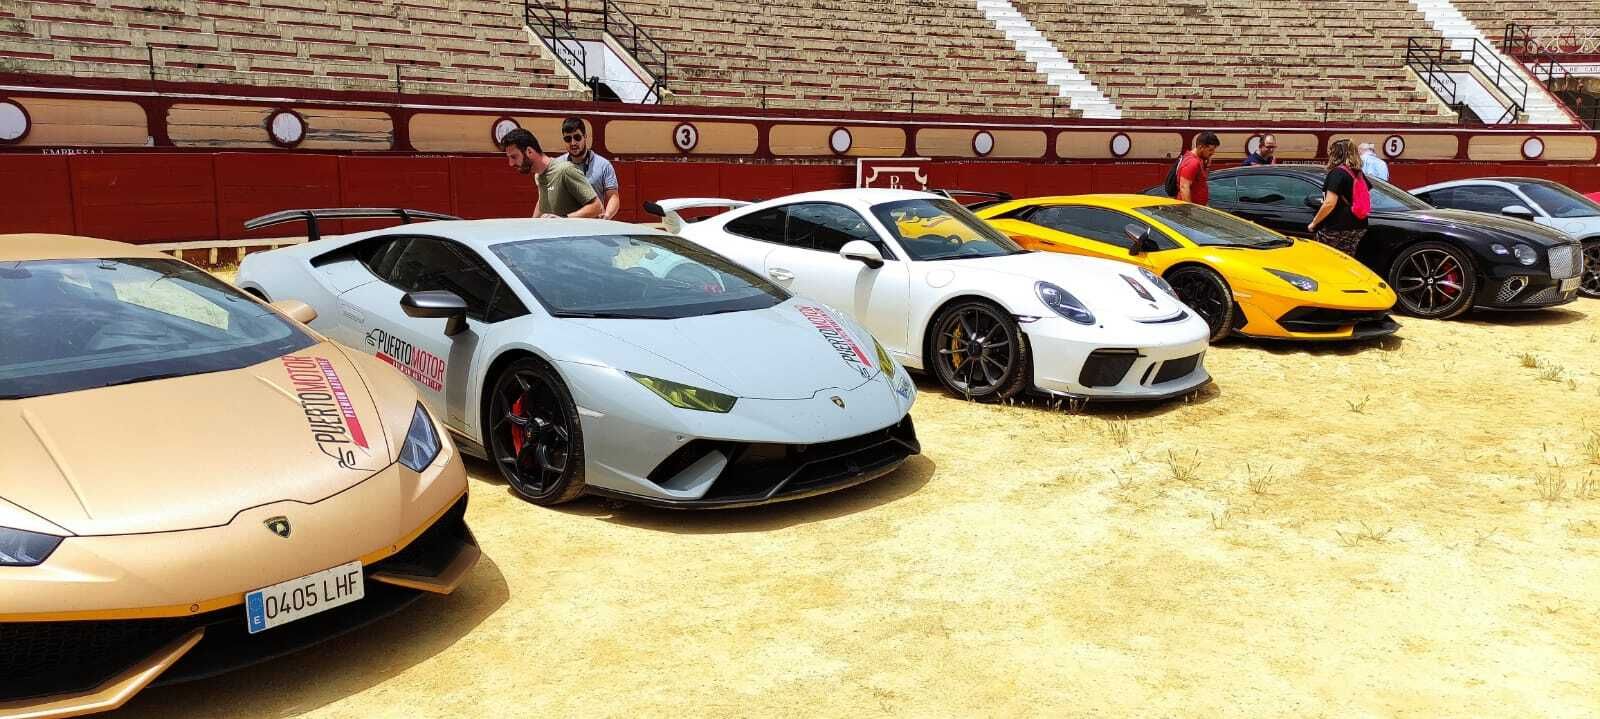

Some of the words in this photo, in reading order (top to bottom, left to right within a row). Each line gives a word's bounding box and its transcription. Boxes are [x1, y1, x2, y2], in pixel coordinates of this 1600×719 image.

[681, 128, 691, 146] 3
[1390, 139, 1398, 153] 5
[377, 329, 446, 382] PUERTOMOTOR
[281, 355, 351, 443] PUERTOMOTOR
[265, 583, 318, 619] 0405
[323, 570, 359, 602] LHF
[253, 615, 262, 625] E
